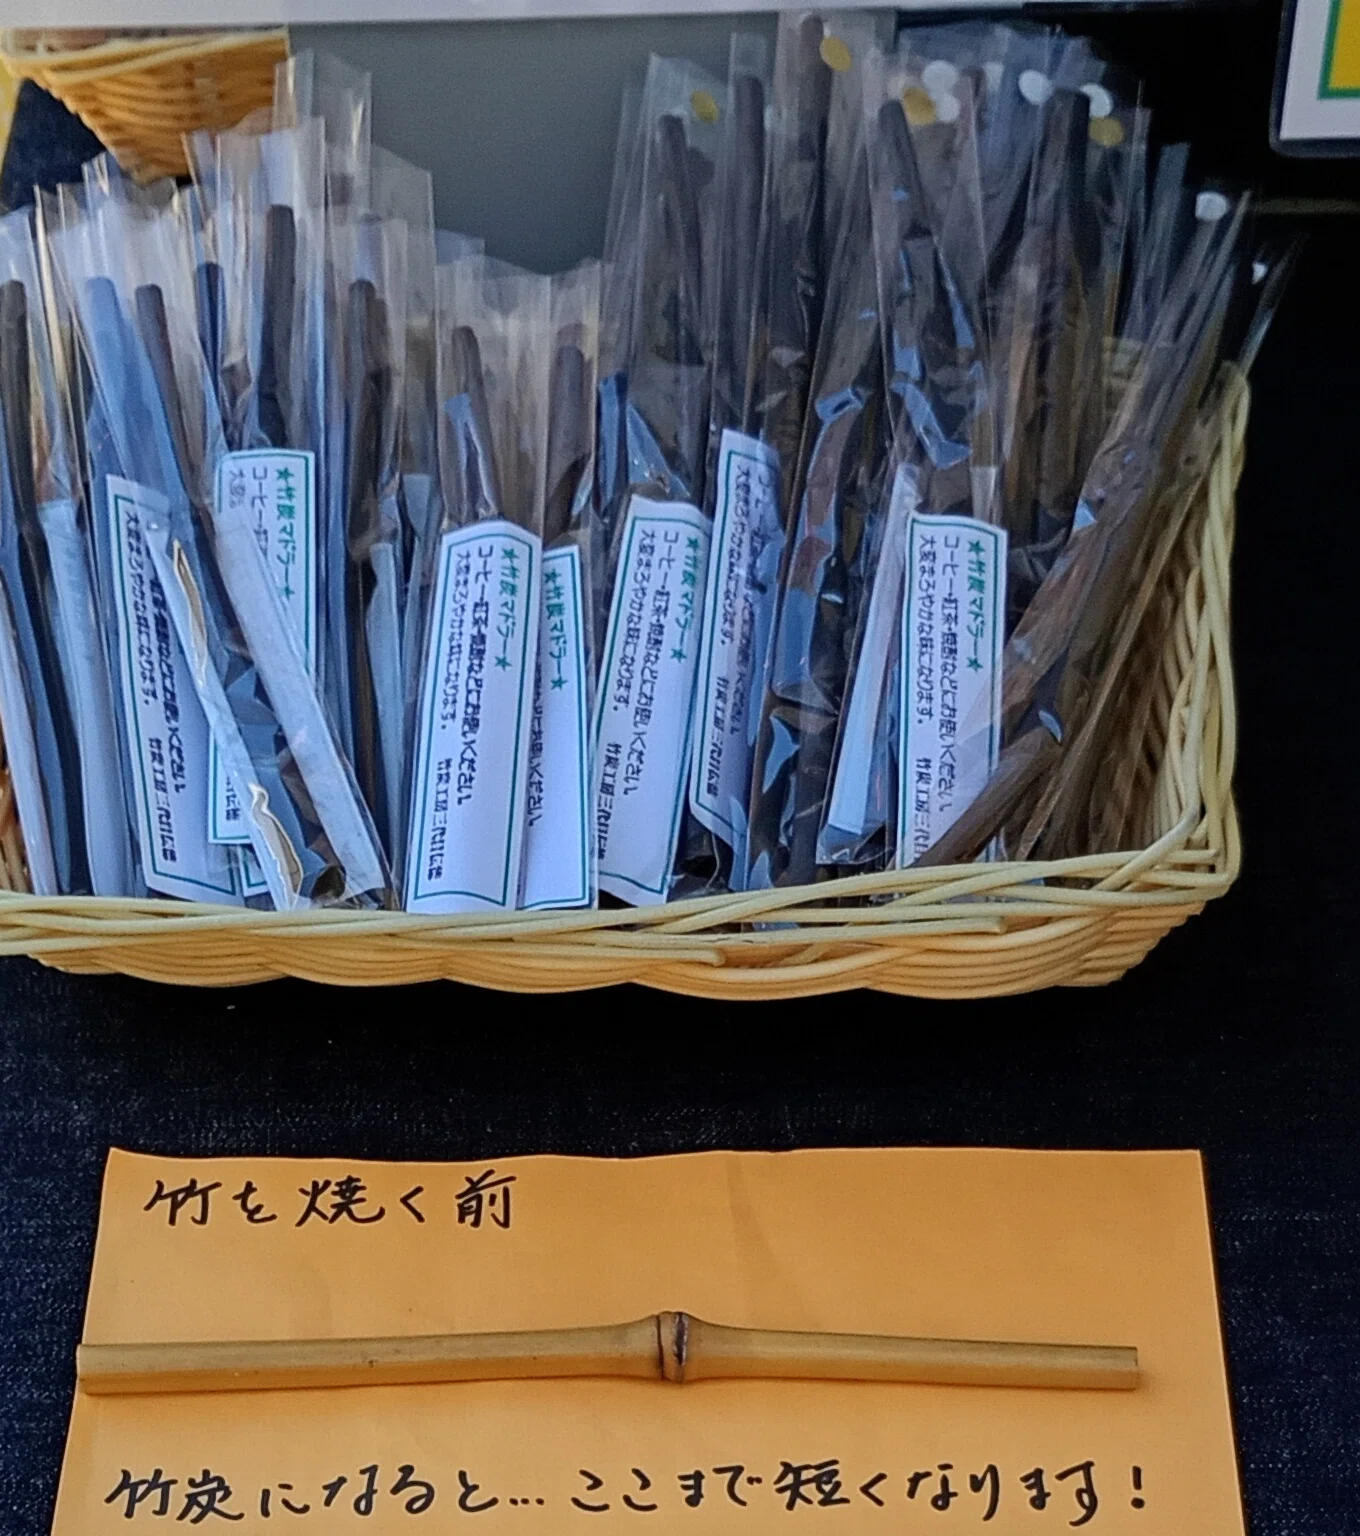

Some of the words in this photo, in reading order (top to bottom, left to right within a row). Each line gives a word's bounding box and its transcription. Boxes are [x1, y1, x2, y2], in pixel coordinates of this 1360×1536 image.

[141, 1170, 519, 1232] 竹を焼く前
